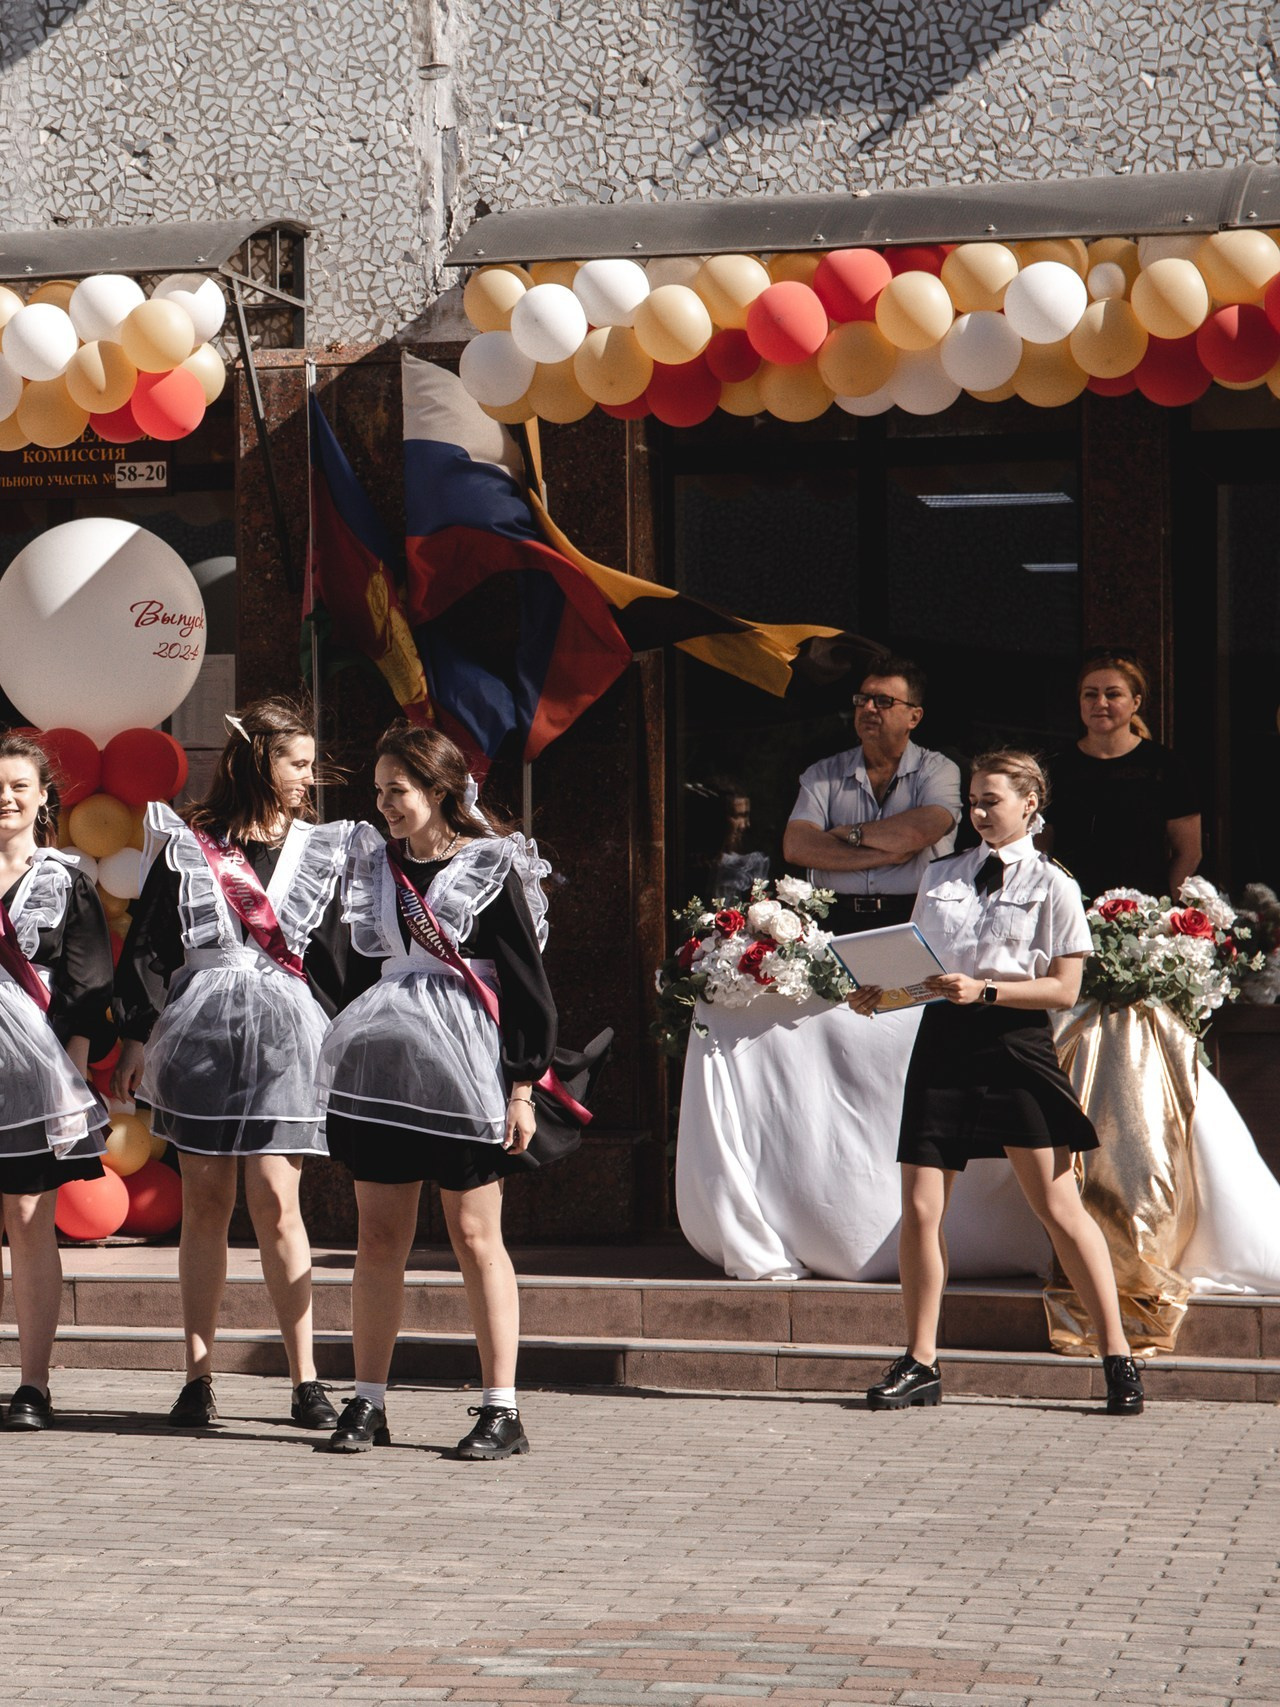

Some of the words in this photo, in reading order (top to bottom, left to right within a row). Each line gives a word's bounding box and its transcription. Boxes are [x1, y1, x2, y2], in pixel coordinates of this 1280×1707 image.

[23, 447, 126, 464] КОМИССИЯ
[47, 473, 98, 487] УЧАСТКА
[129, 600, 204, 638] Выпуск
[152, 642, 200, 661] 2024
